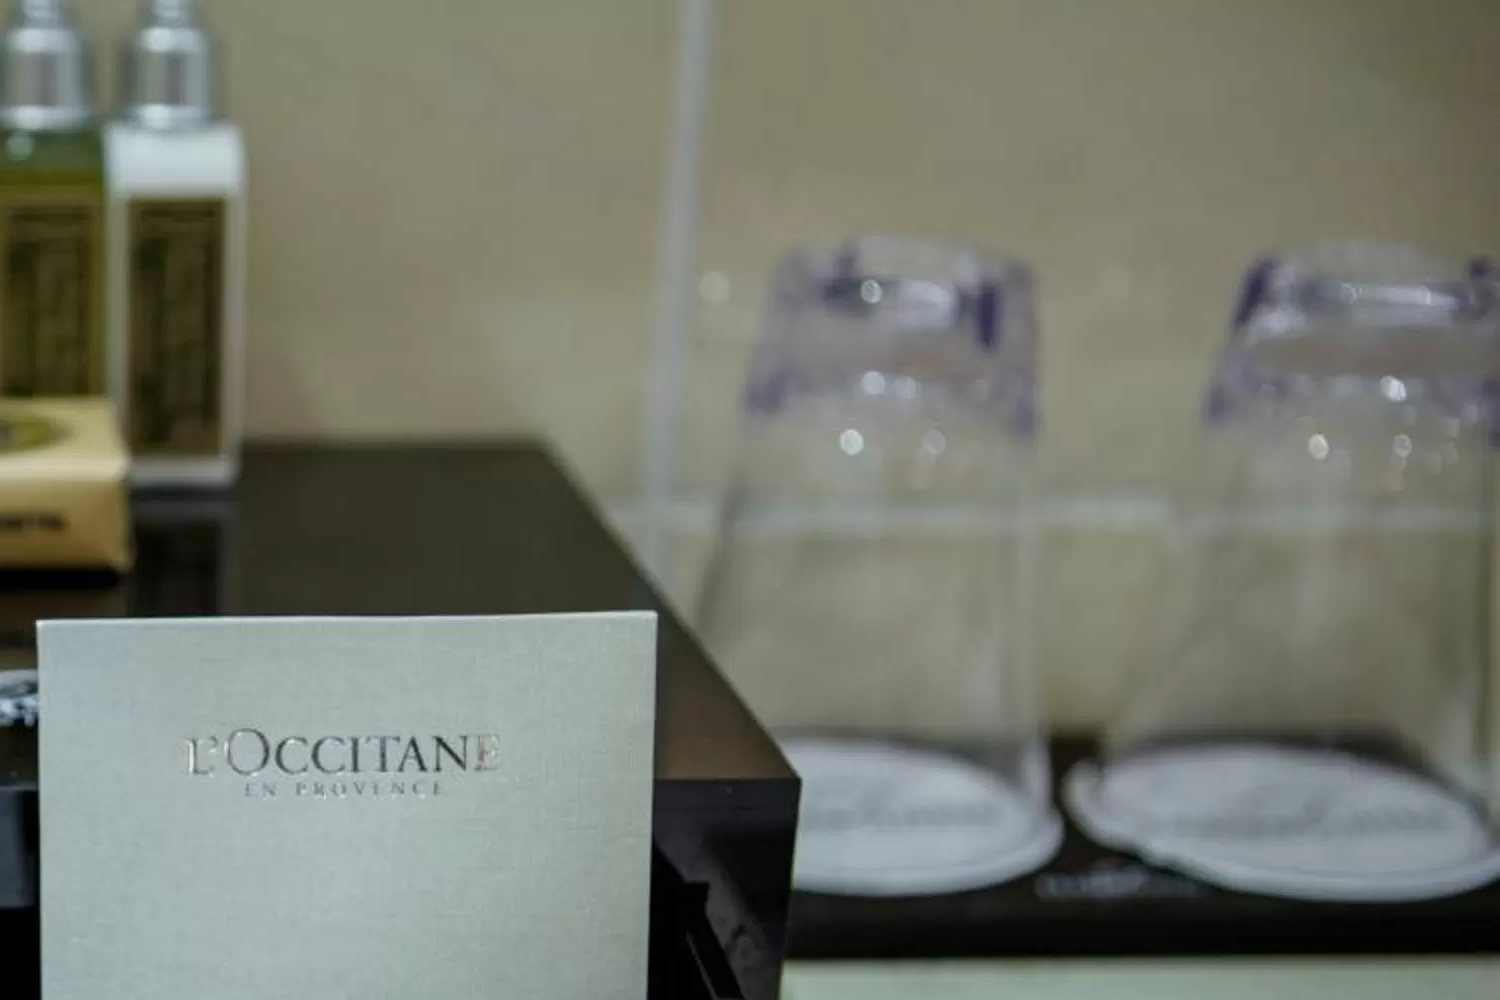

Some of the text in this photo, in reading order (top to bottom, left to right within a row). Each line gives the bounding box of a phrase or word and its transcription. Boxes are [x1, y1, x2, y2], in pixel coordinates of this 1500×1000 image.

[184, 727, 500, 776] L'OCCITANE
[244, 781, 442, 797] EN PROVENCE
